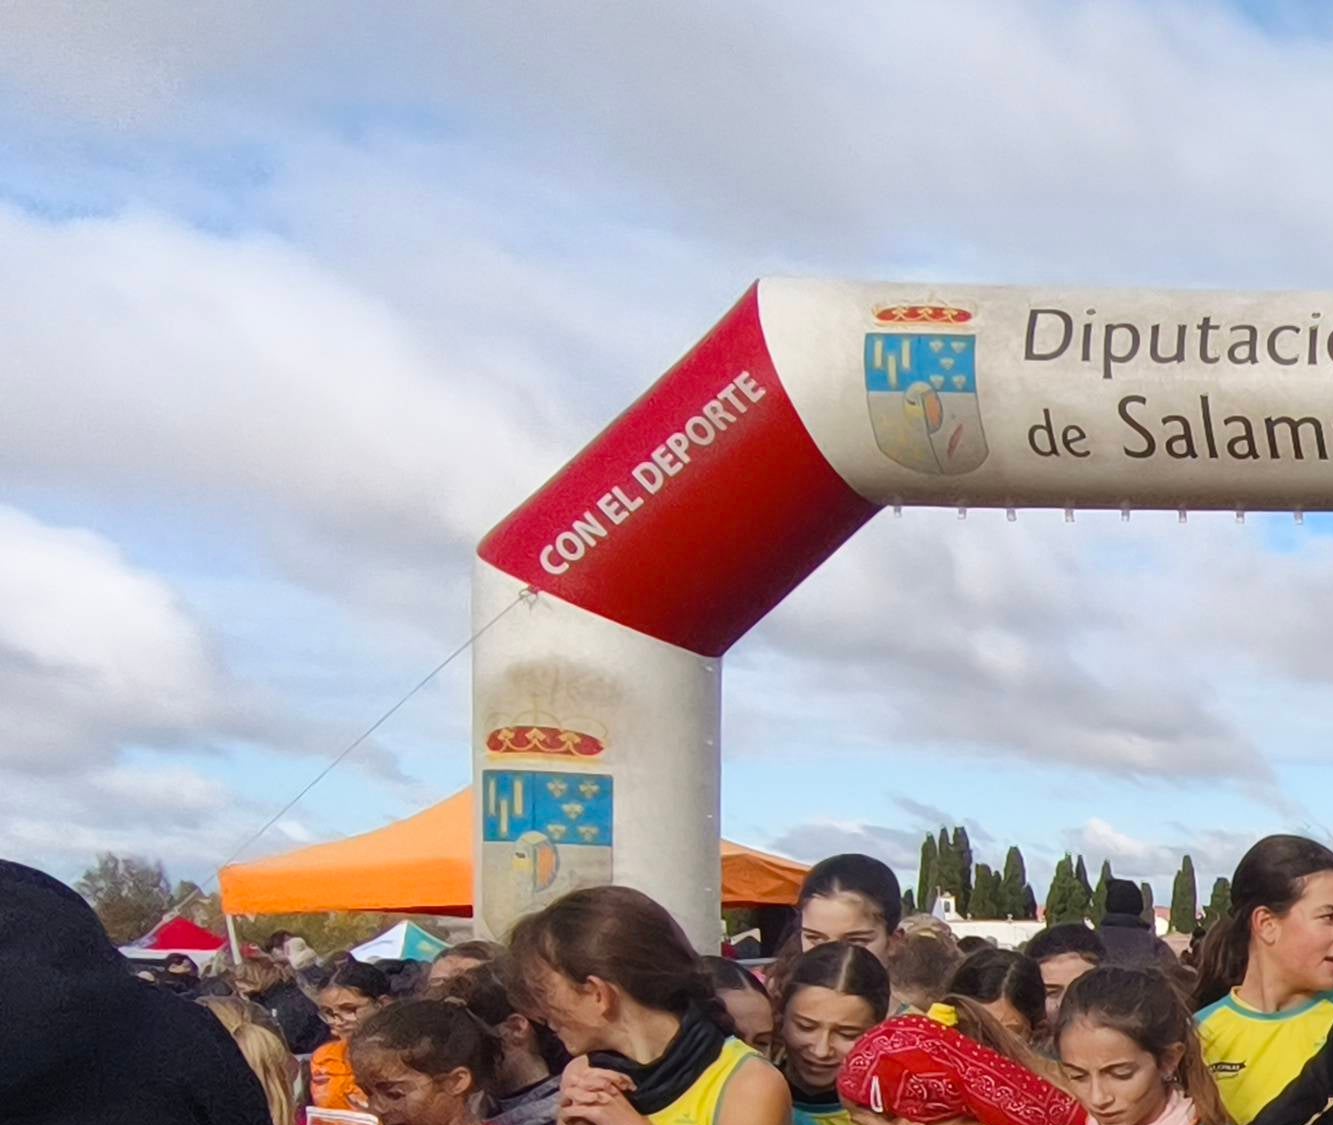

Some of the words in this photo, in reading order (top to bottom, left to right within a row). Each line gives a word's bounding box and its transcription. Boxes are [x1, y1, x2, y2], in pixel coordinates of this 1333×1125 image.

[539, 511, 608, 575] CON
[597, 486, 644, 525] EL
[632, 371, 766, 494] DEPORTE
[1028, 408, 1090, 458] de
